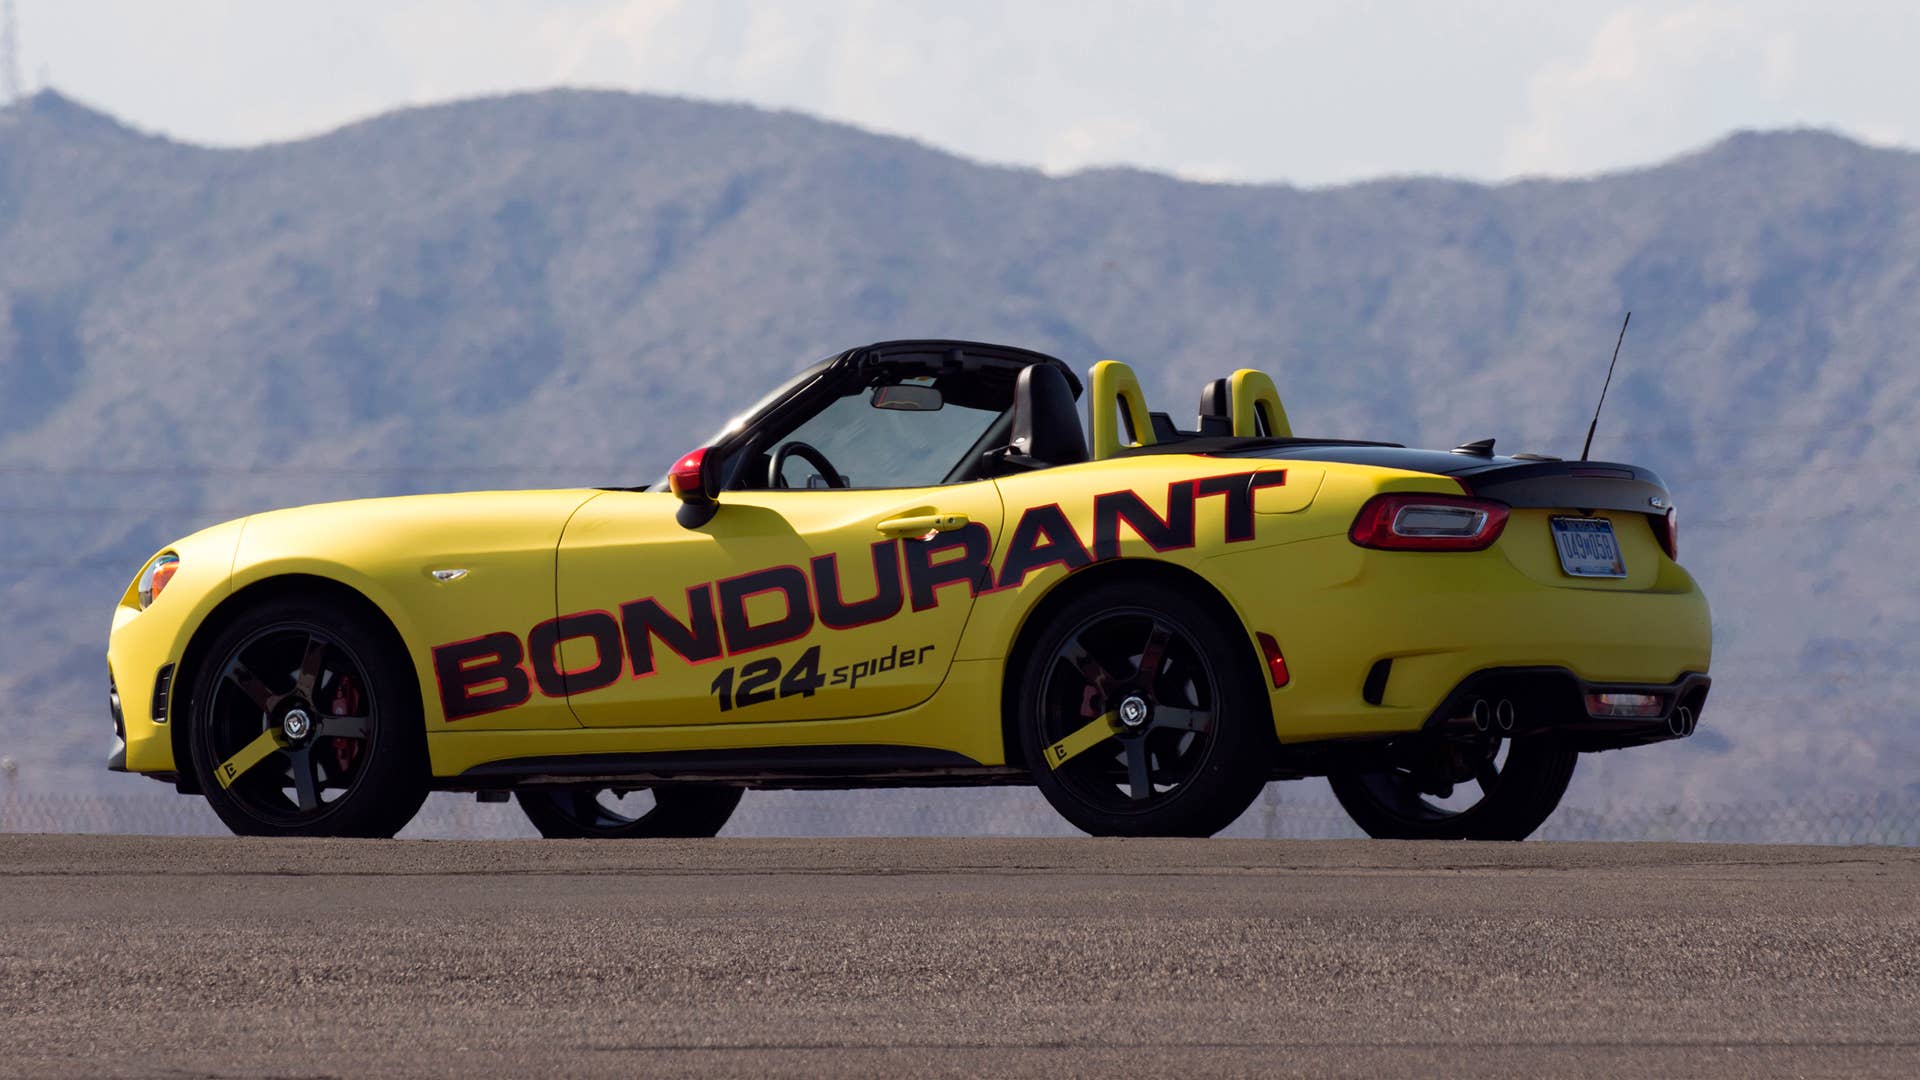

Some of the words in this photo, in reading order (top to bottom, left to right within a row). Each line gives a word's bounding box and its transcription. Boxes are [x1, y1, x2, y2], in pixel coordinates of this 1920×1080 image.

[431, 468, 1288, 723] BONDURANT
[711, 645, 826, 712] 124
[830, 645, 935, 689] spider
